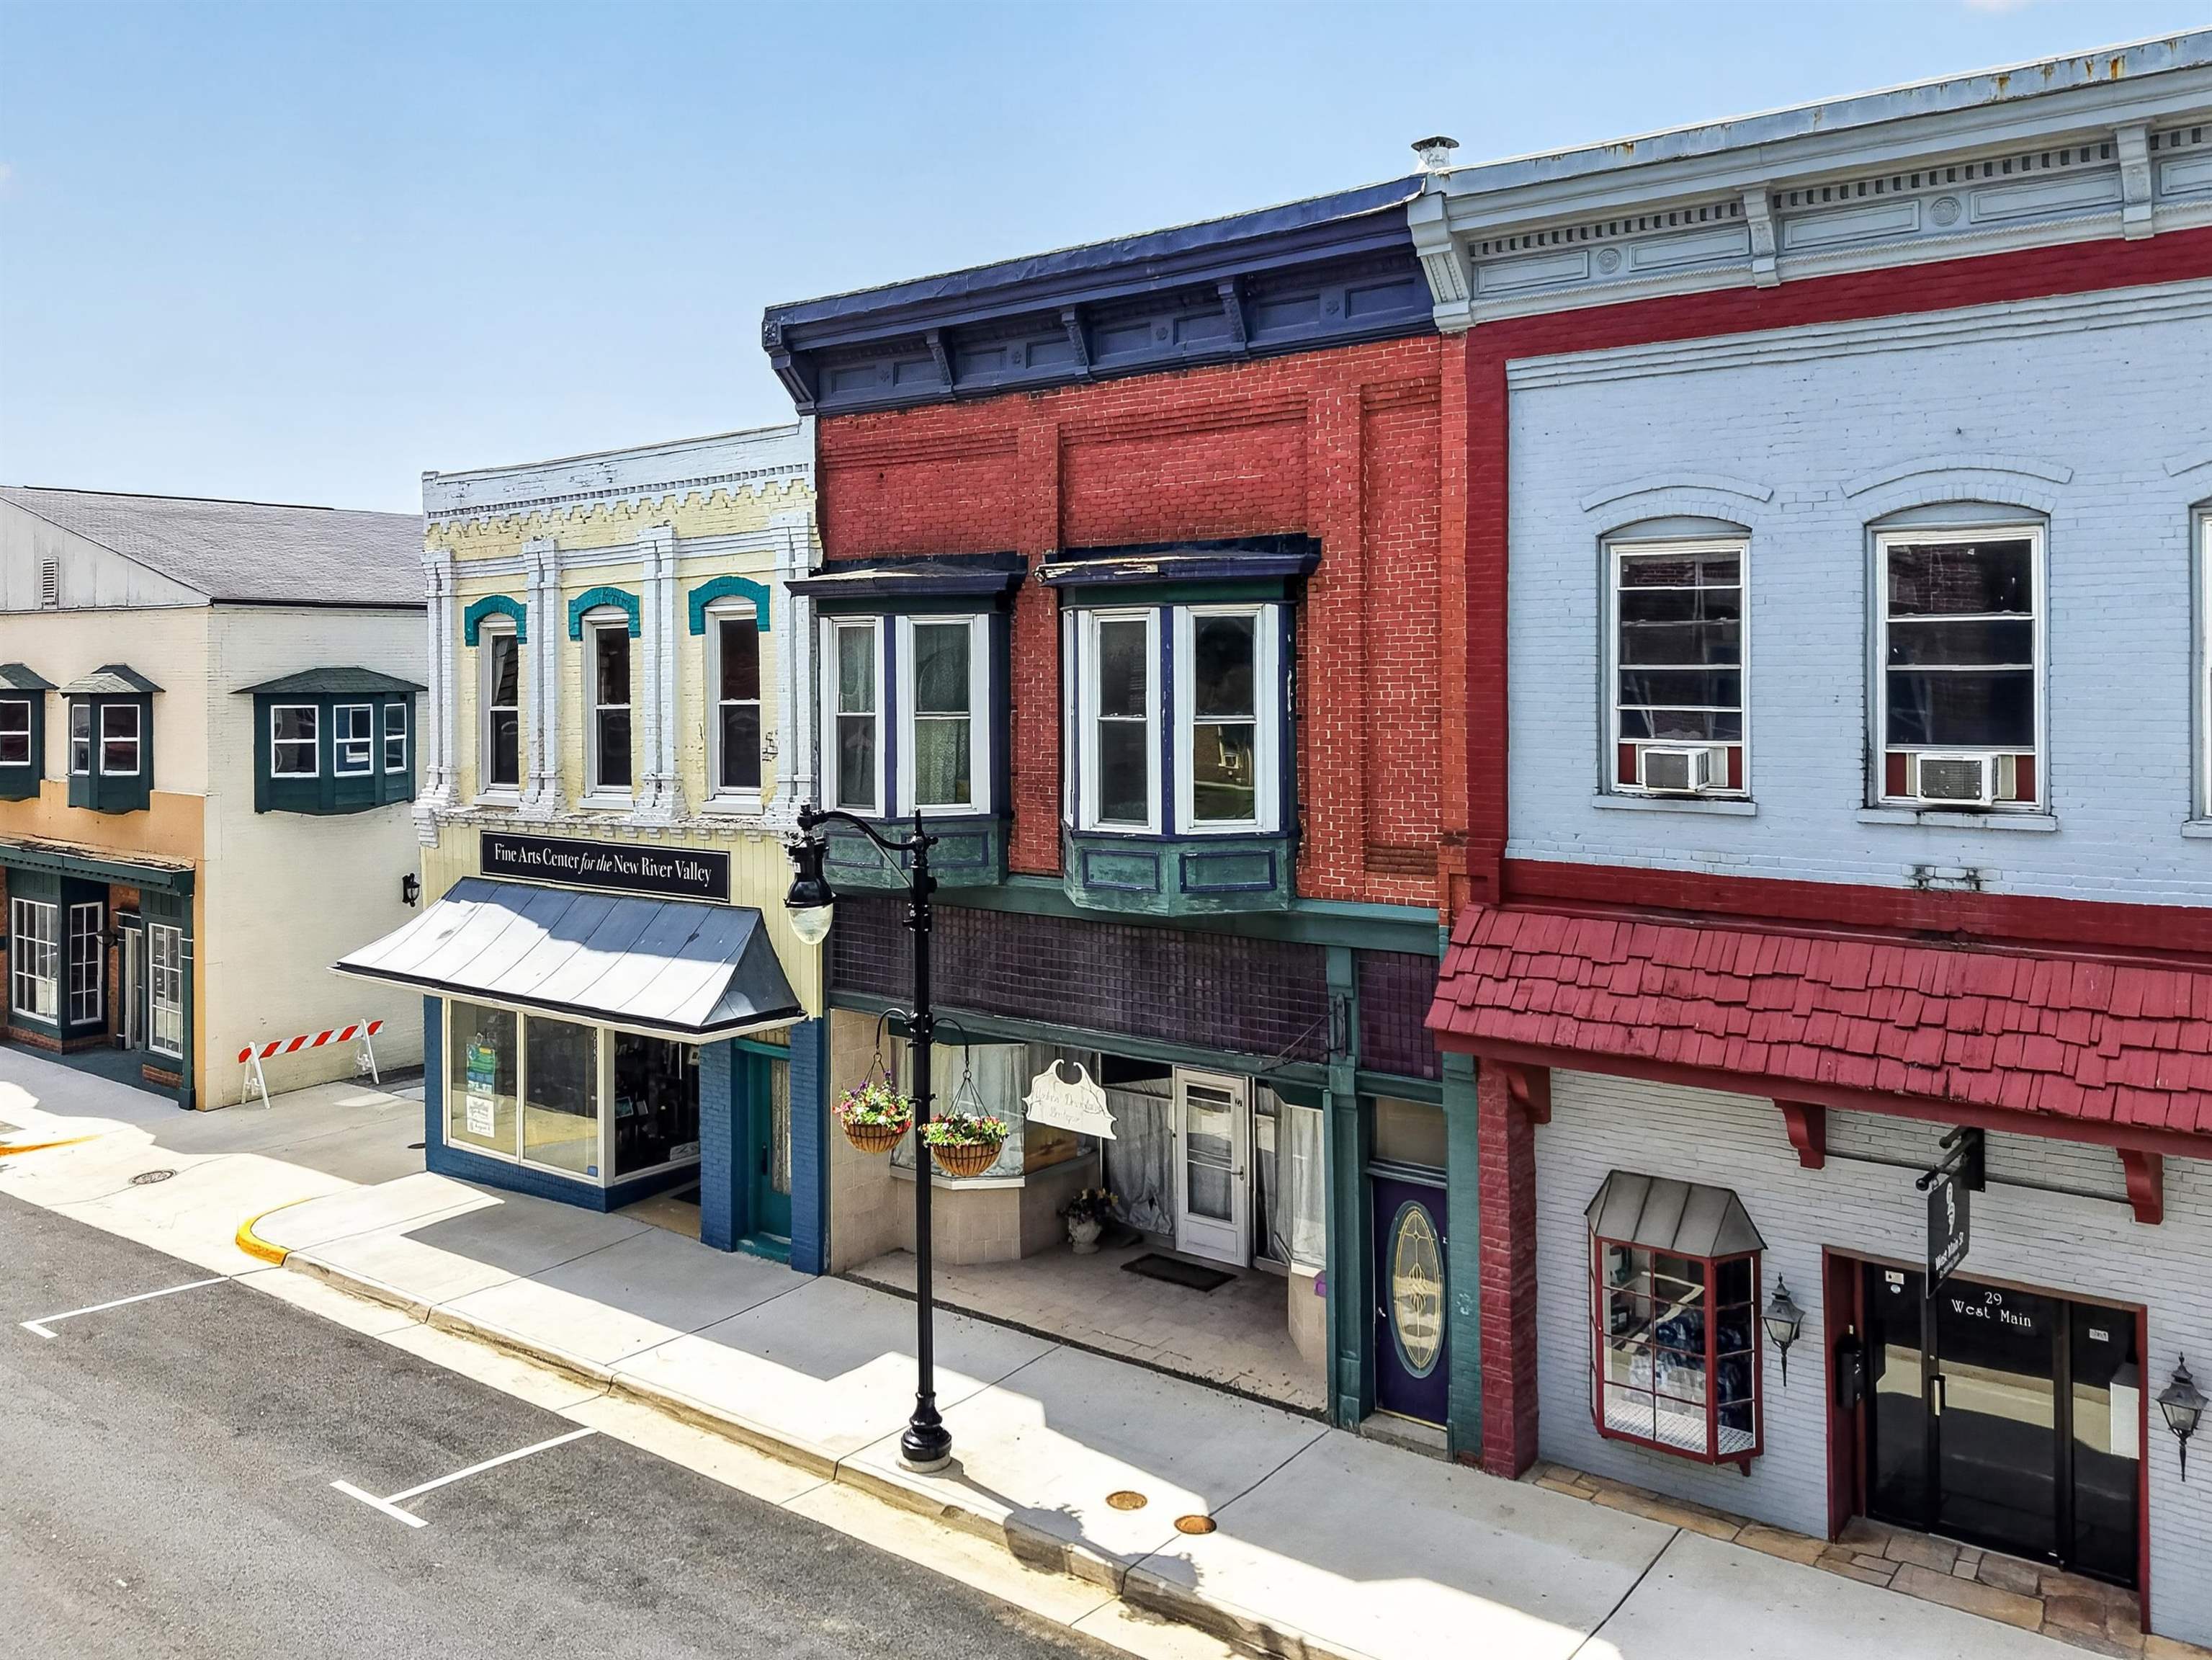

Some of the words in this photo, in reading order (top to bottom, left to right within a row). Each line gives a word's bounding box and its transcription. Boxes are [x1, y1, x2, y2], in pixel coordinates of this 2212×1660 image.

[494, 842, 517, 862] Fine
[518, 847, 542, 865] Arts
[542, 847, 580, 870] Center
[578, 852, 595, 875] for
[596, 854, 613, 872] the
[614, 854, 640, 874] New
[641, 857, 673, 878] River
[674, 859, 712, 887] Valley
[1951, 1298, 1991, 1319] West
[2000, 1308, 2032, 1327] Main
[1984, 1290, 2002, 1306] 29
